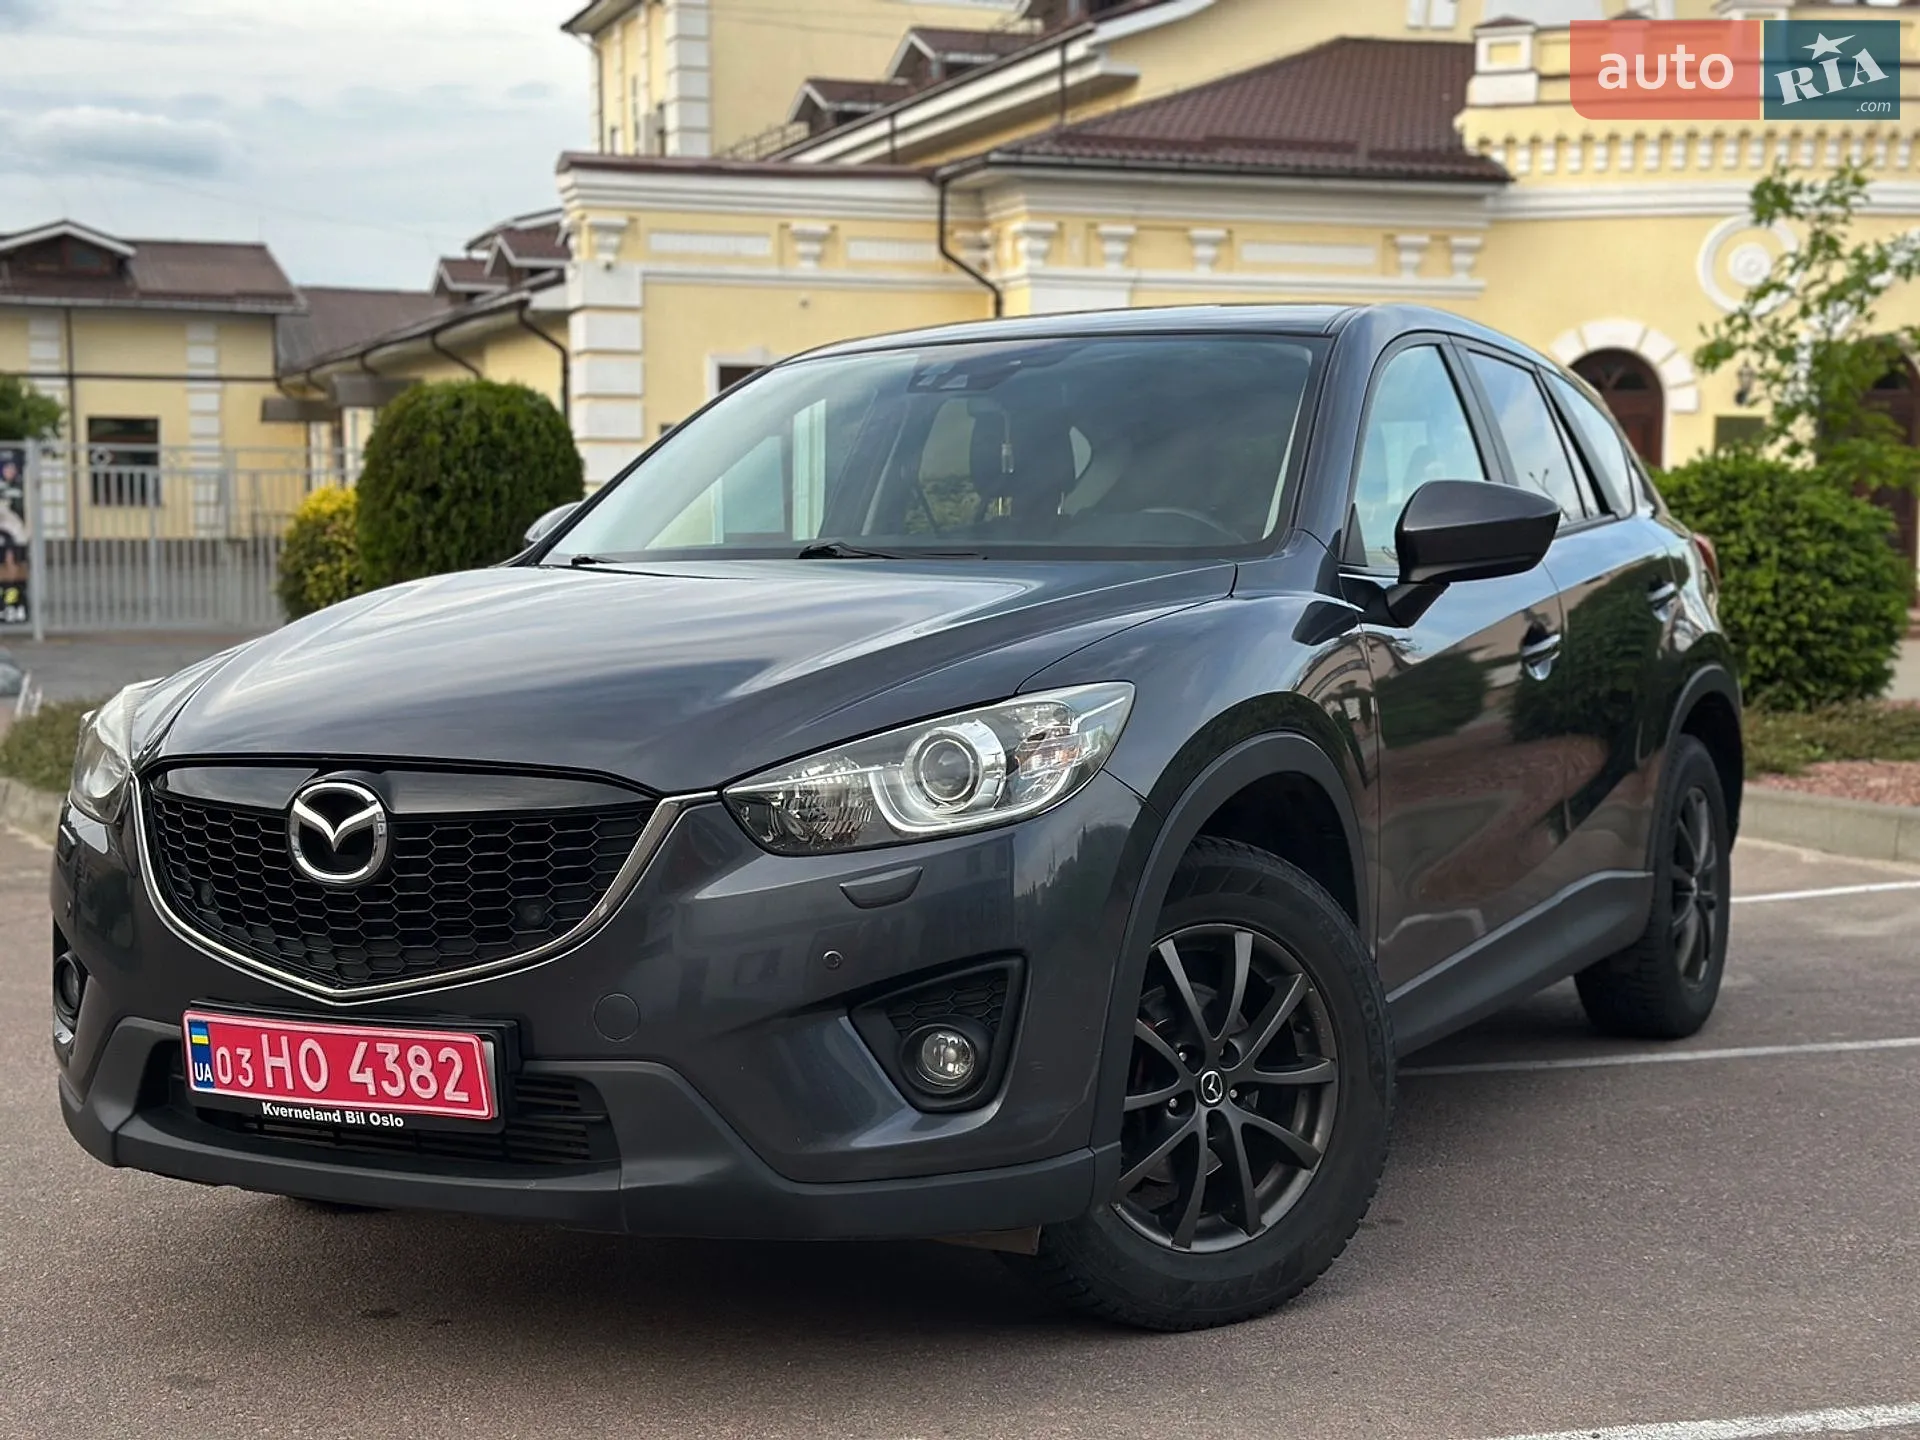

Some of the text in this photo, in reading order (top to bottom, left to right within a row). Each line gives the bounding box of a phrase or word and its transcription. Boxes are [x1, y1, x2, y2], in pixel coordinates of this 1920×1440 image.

[194, 1061, 214, 1082] UA
[215, 1045, 255, 1087] 03
[349, 1040, 470, 1103] 4382
[262, 1101, 404, 1128] Kverneland Bil Oslo
